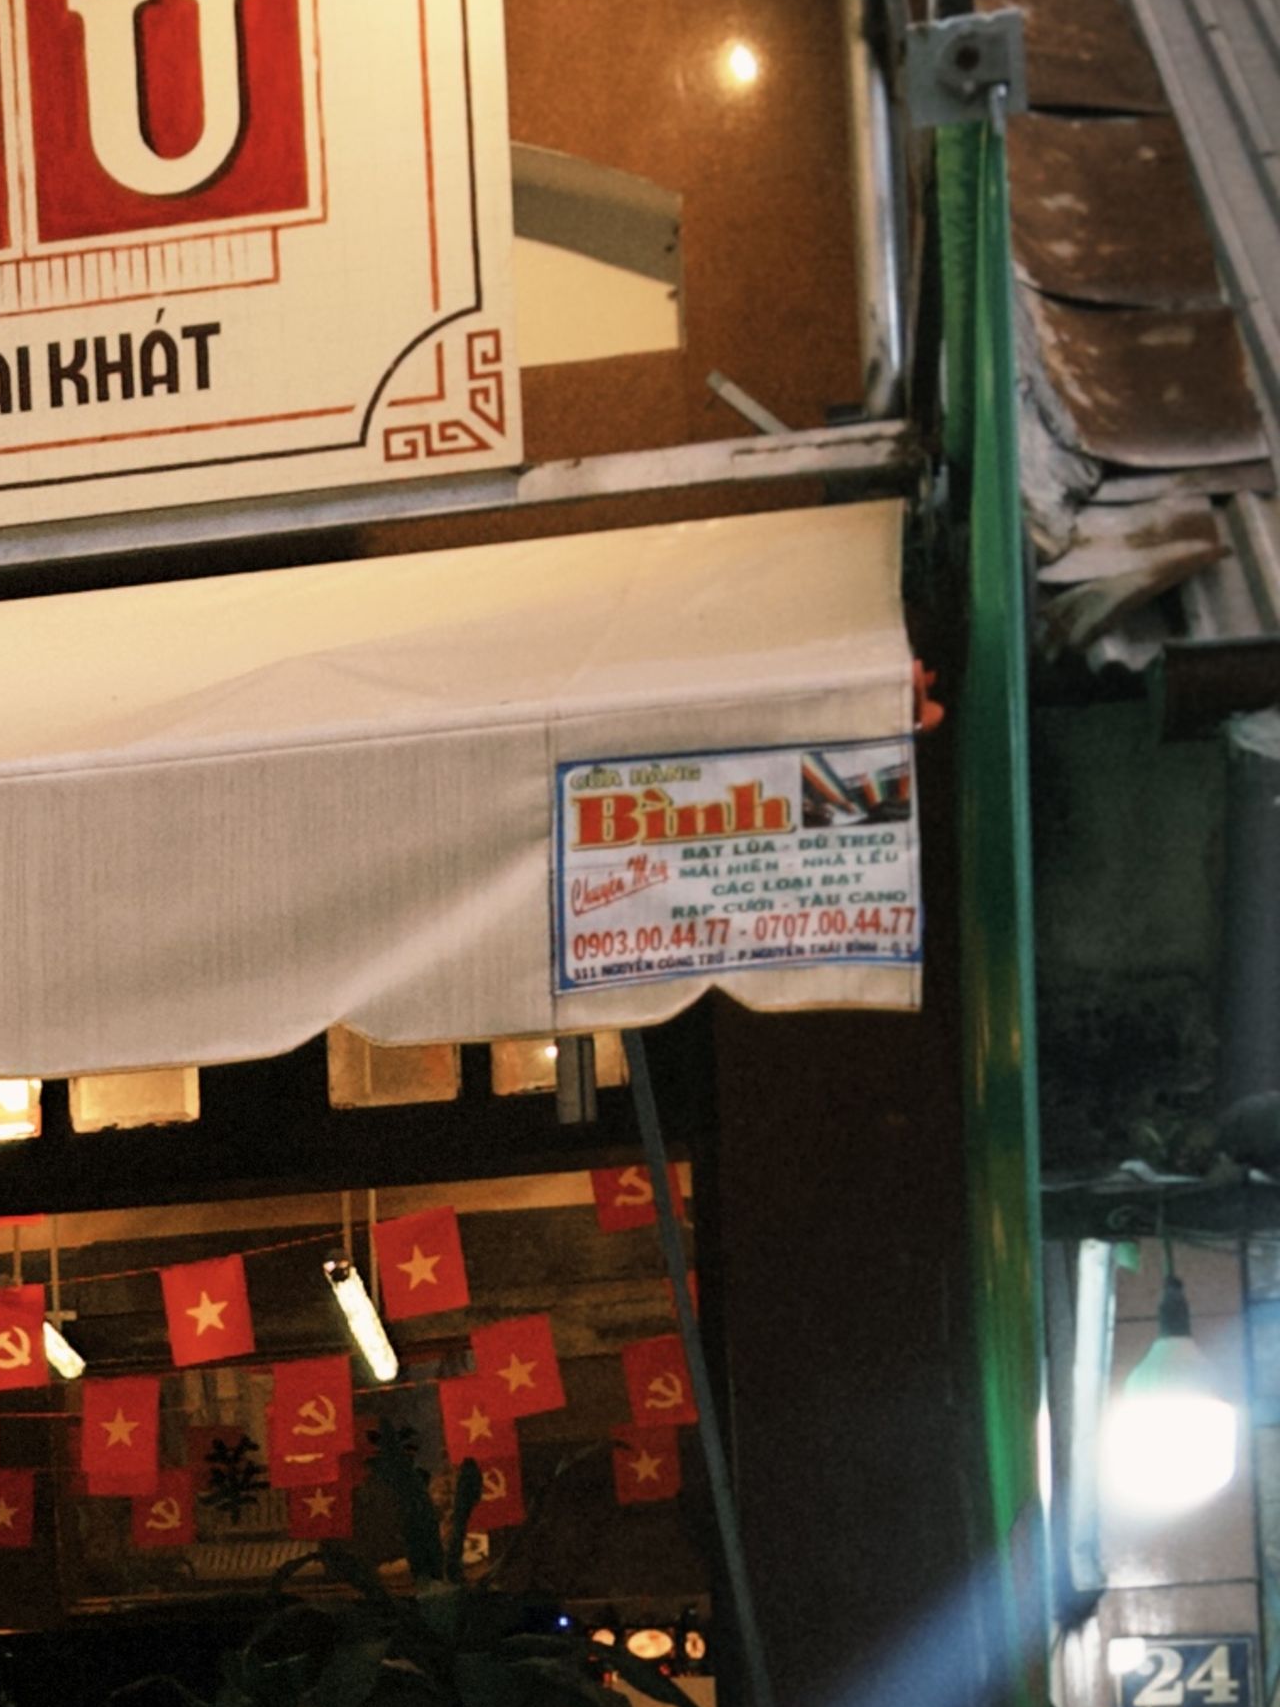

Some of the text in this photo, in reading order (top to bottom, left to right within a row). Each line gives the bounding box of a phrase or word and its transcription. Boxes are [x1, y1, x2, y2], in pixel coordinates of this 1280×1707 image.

[47, 306, 221, 408] KHÁT
[570, 780, 797, 851] Bình
[836, 831, 896, 850] TREO
[712, 879, 755, 897] CÁC
[847, 889, 907, 906] CANO
[573, 906, 917, 962] 0903.00.44.77 0707.00.44.77
